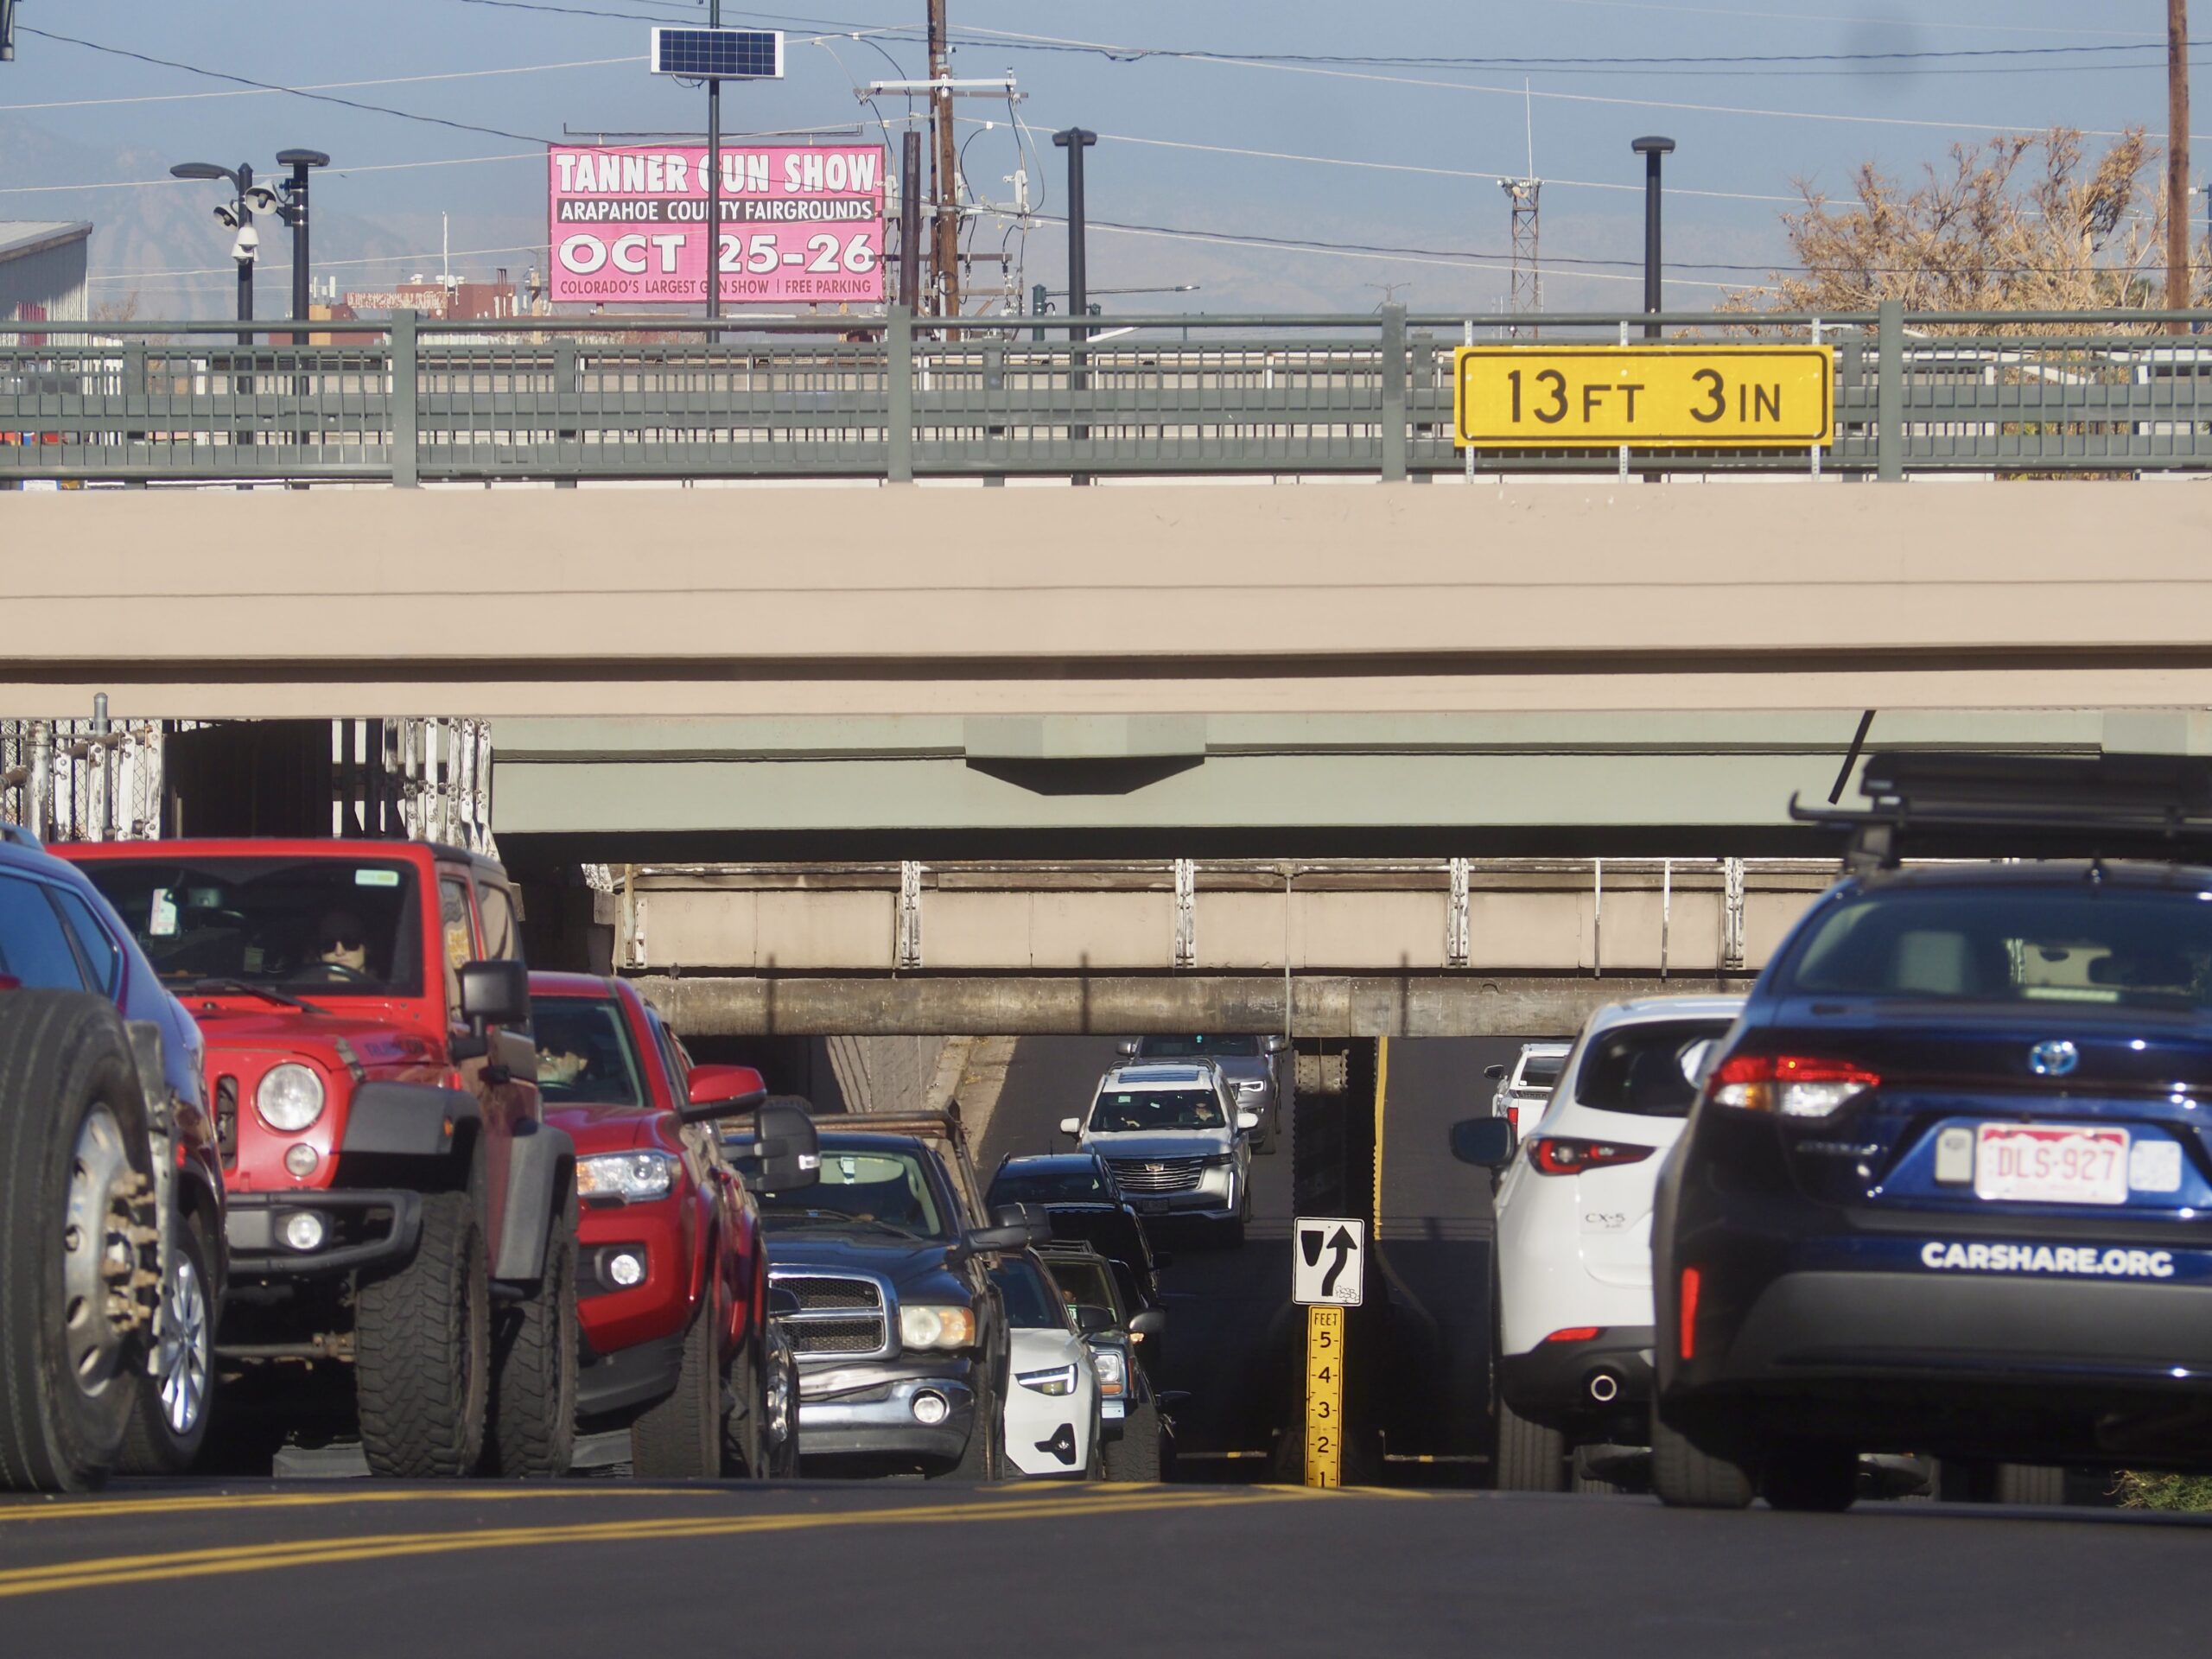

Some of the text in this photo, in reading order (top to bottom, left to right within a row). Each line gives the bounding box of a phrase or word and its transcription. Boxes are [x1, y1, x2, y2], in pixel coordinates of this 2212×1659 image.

[556, 153, 690, 194] TANNER
[784, 153, 876, 194] SHOW
[561, 200, 872, 221] ARAPAHOE COUTY FAIRGROUNDS
[558, 233, 876, 276] OCT 25-26
[560, 279, 872, 295] COLORADO'S LARGEST GN SHOW FREE PARKING
[1585, 1212, 1625, 1224] CX-5
[1921, 1241, 2175, 1278] CARSHARE.ORG
[1314, 1313, 1338, 1326] FEET
[1320, 1332, 1332, 1348] 5
[1318, 1366, 1331, 1383] 4
[1318, 1402, 1330, 1418] 3
[1318, 1437, 1329, 1453] 2
[1319, 1471, 1325, 1487] 1
